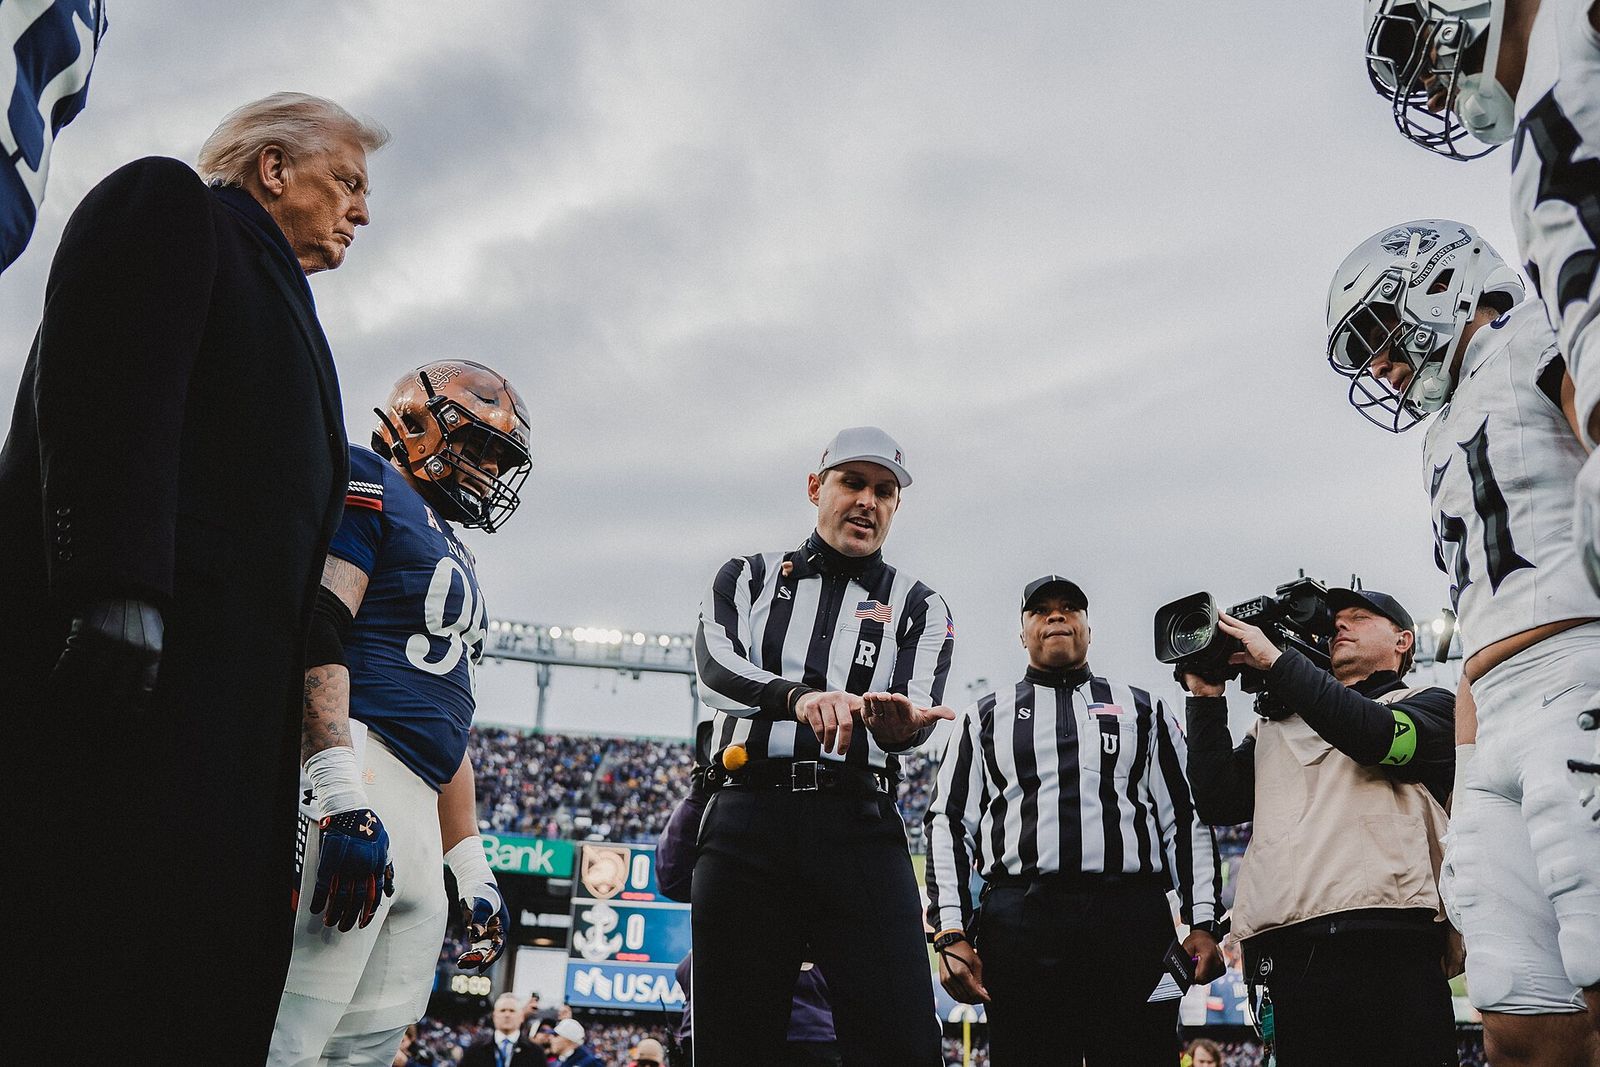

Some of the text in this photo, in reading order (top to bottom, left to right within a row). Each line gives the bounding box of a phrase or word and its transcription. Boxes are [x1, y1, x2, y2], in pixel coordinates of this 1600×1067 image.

[1412, 263, 1434, 285] UNITED
[1432, 244, 1453, 264] STATES
[1440, 253, 1456, 267] 1775
[855, 640, 877, 668] R
[1018, 708, 1031, 720] S
[1102, 733, 1118, 754] U
[480, 834, 554, 873] Bank
[631, 854, 650, 890] 0
[626, 914, 645, 950] 0
[613, 973, 686, 1004] USAA
